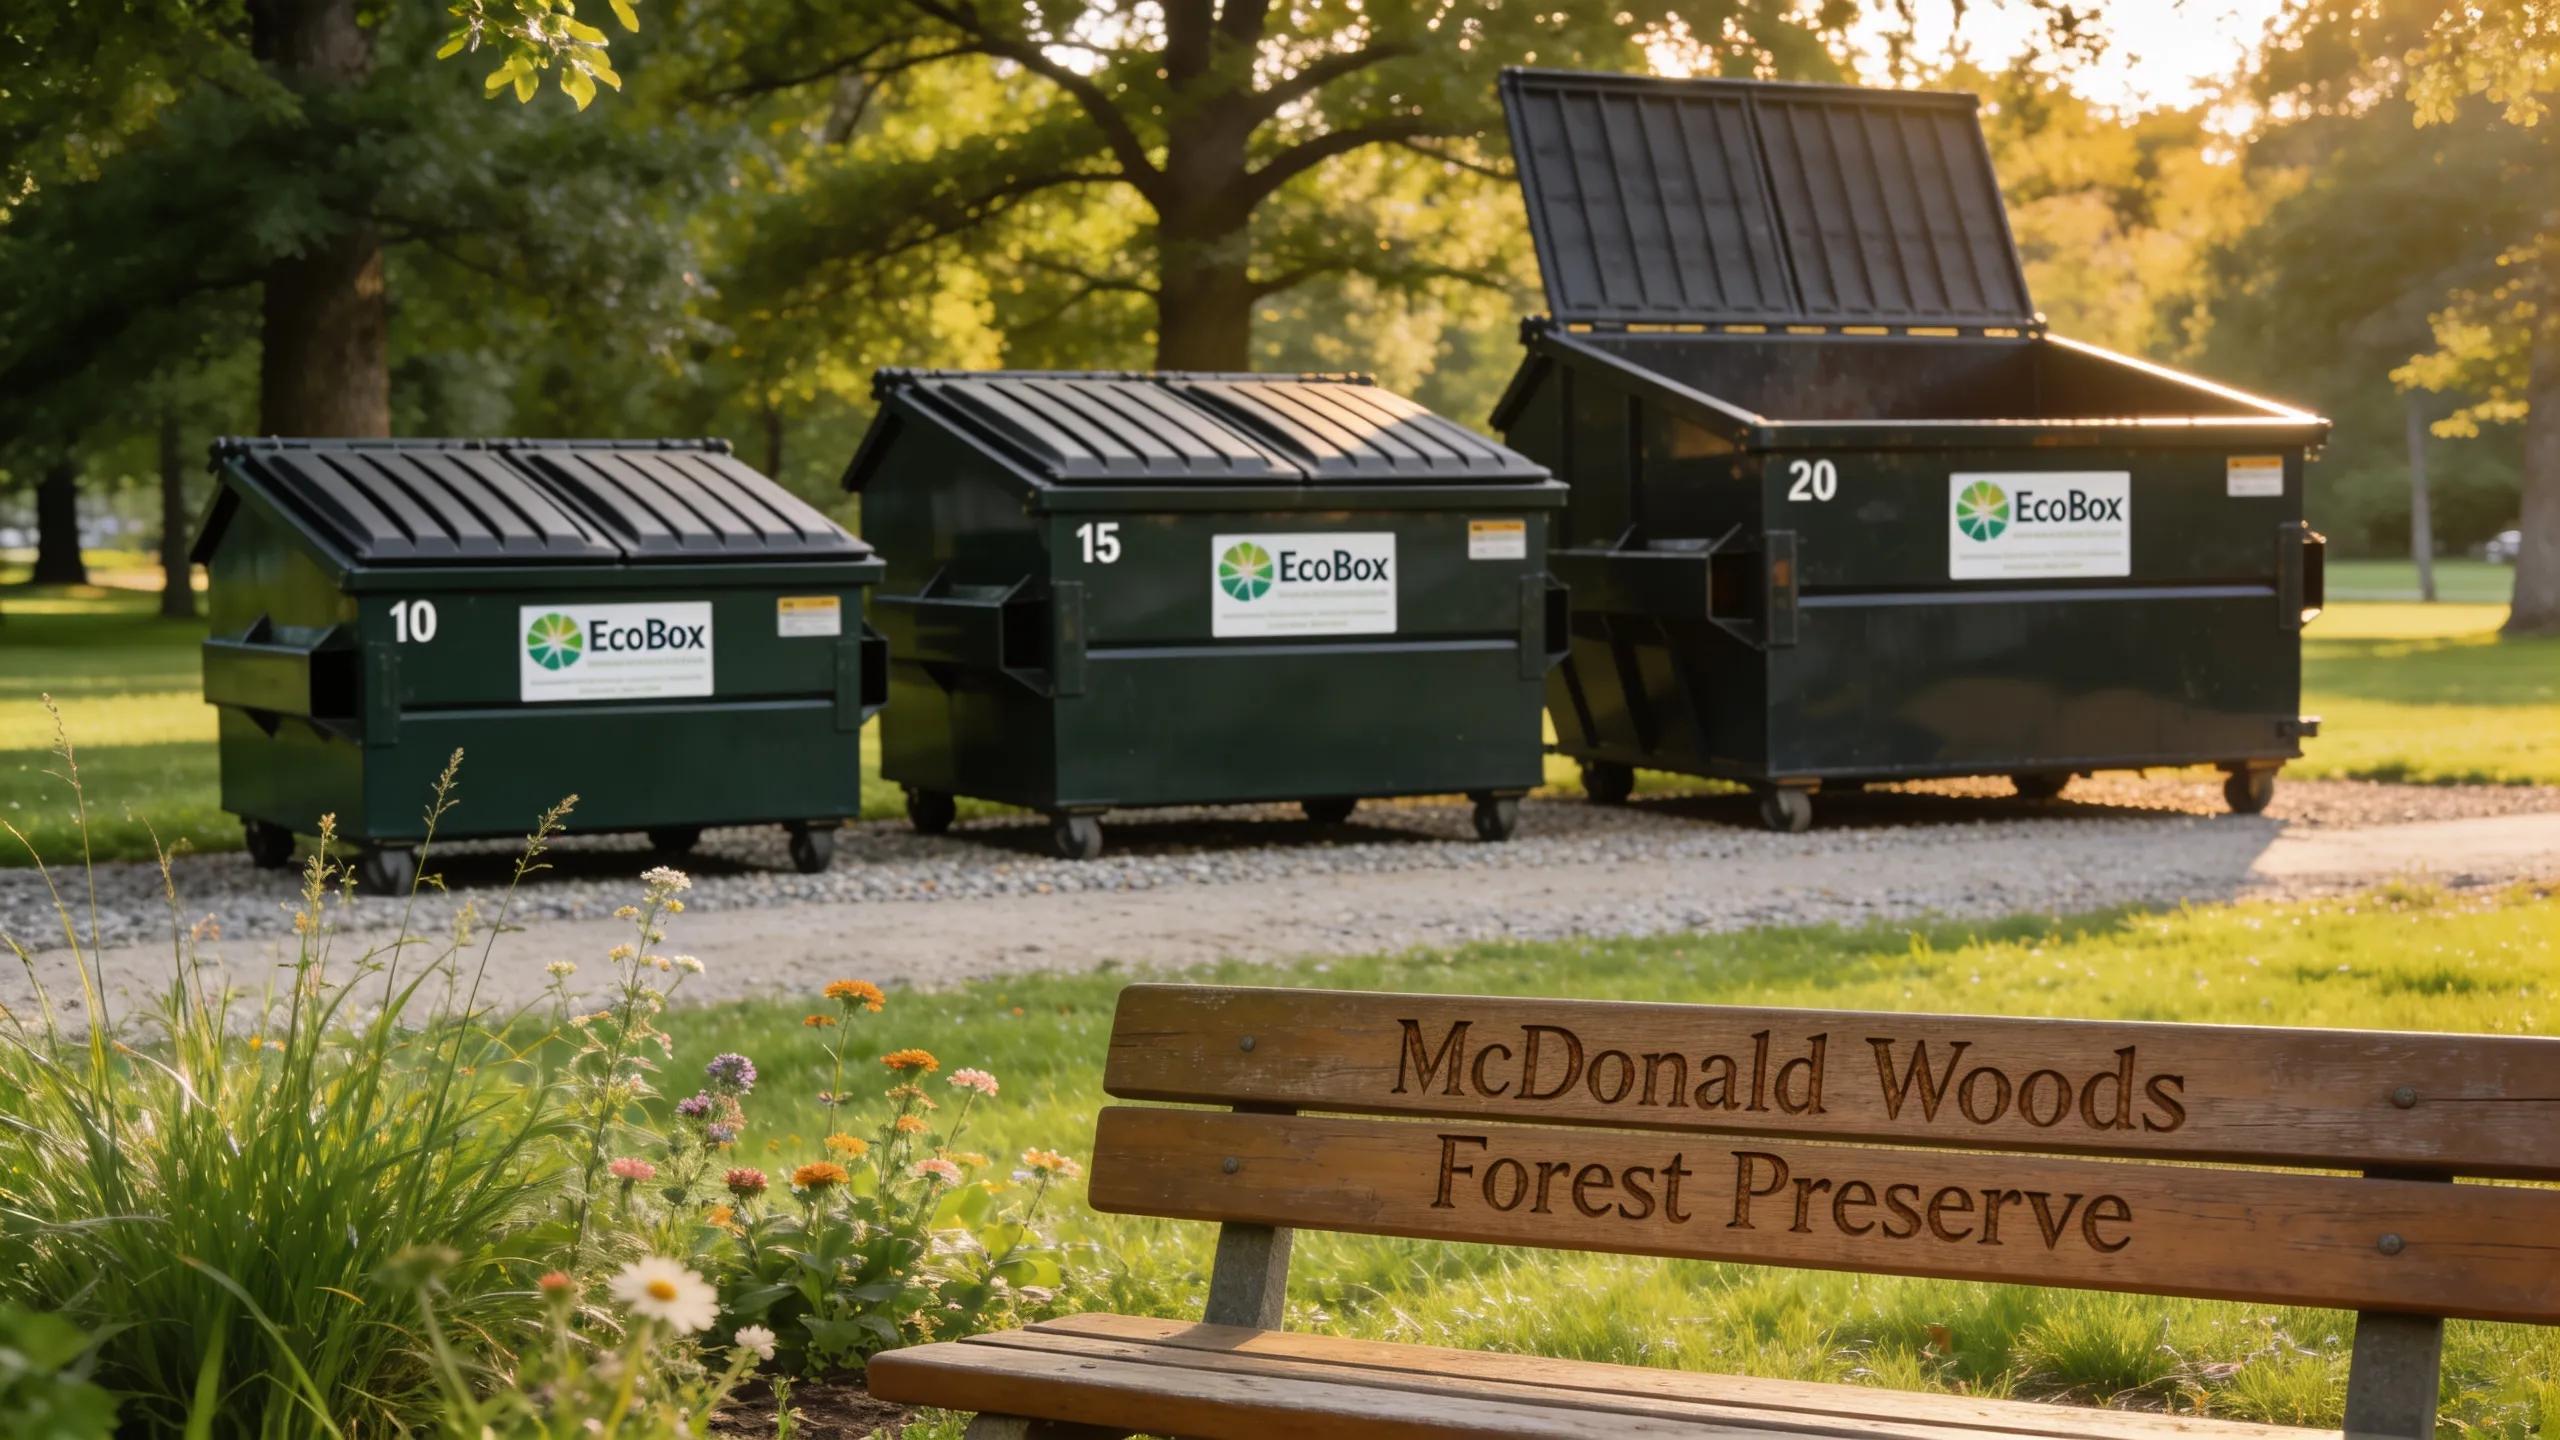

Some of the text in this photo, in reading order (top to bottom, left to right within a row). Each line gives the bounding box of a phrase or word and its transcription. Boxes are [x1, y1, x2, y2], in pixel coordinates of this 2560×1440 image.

[1788, 459, 1837, 501] 20
[2015, 489, 2123, 523] EcoBox
[1076, 522, 1121, 563] 15
[1279, 549, 1388, 582] EcoBox
[389, 600, 437, 642] 10
[588, 618, 705, 652] EcoBox
[1391, 1018, 2186, 1133] McDonald Woods
[1430, 1134, 2133, 1254] Forest Preserve
